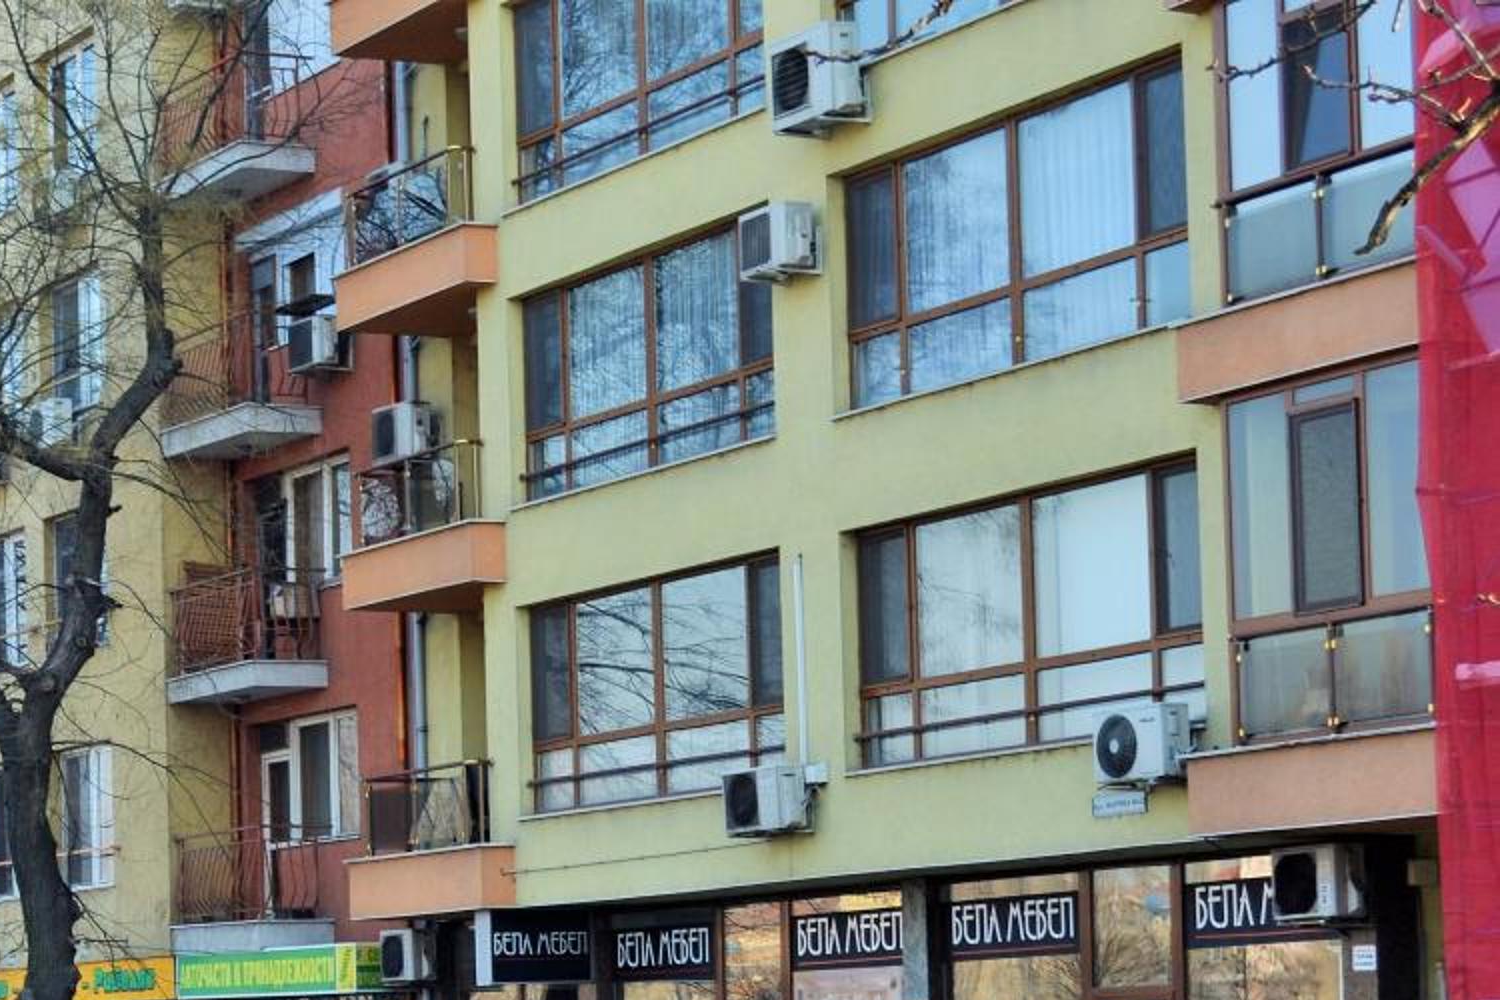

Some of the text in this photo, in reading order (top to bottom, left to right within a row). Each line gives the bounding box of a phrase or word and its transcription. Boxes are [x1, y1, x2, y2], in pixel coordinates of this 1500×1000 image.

[1006, 897, 1075, 942] МЕБЕЛ
[537, 931, 588, 955] МЕБЕЛ
[658, 927, 709, 966] МЕБЕЛ
